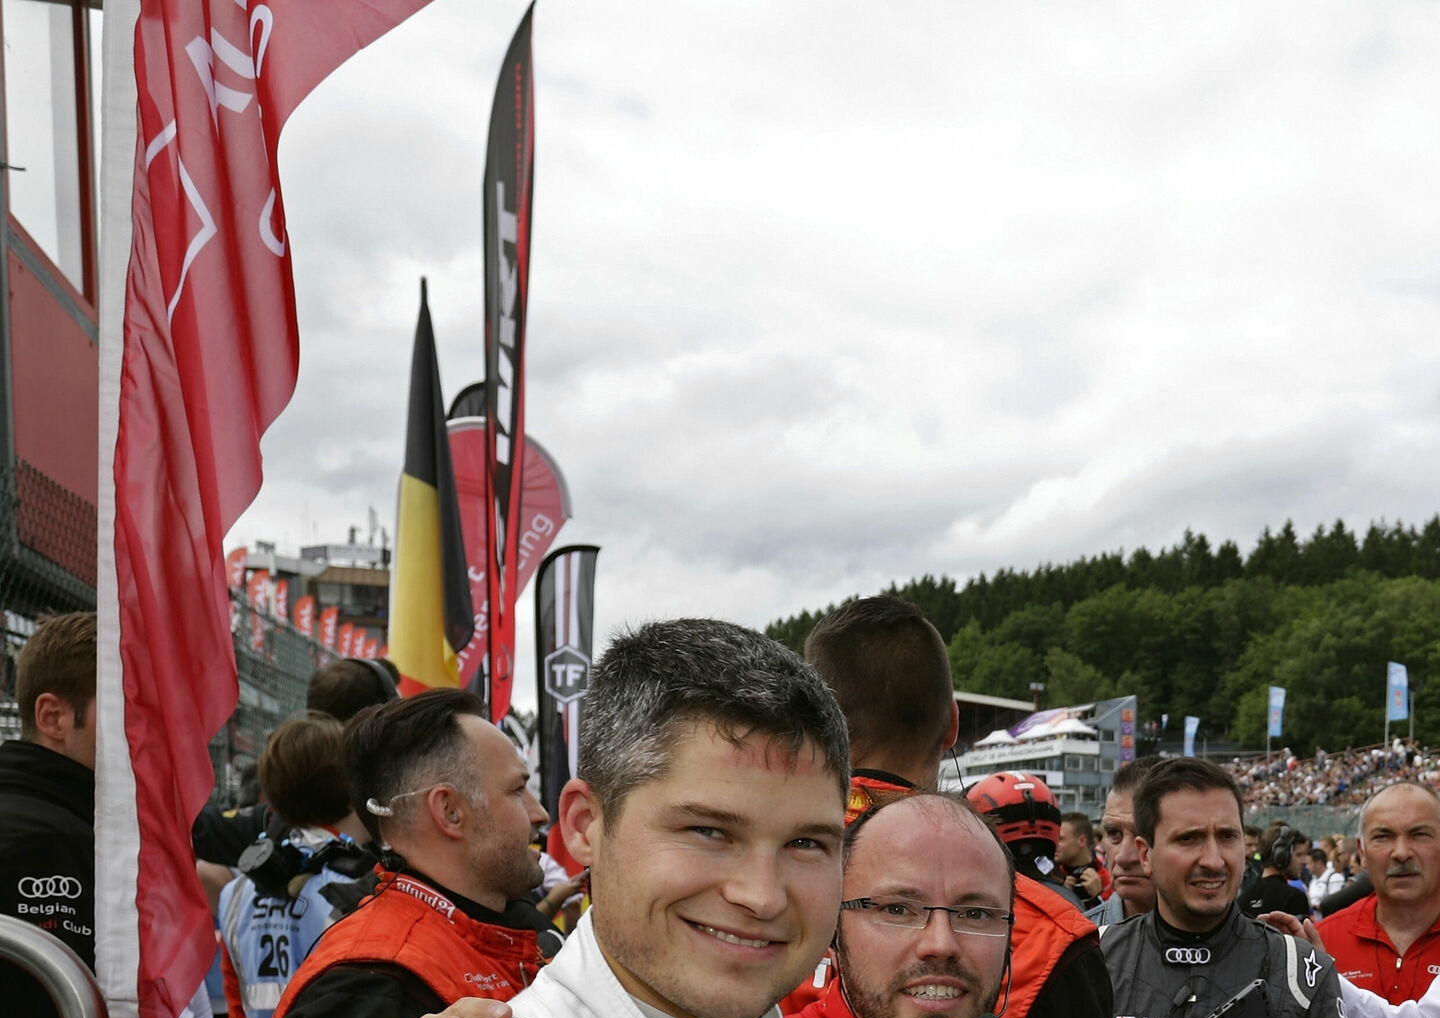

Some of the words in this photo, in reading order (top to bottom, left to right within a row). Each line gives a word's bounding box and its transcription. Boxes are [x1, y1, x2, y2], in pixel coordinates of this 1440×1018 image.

[552, 663, 586, 687] TF
[18, 902, 76, 915] Belgian
[63, 920, 92, 936] Club
[257, 934, 289, 978] 26
